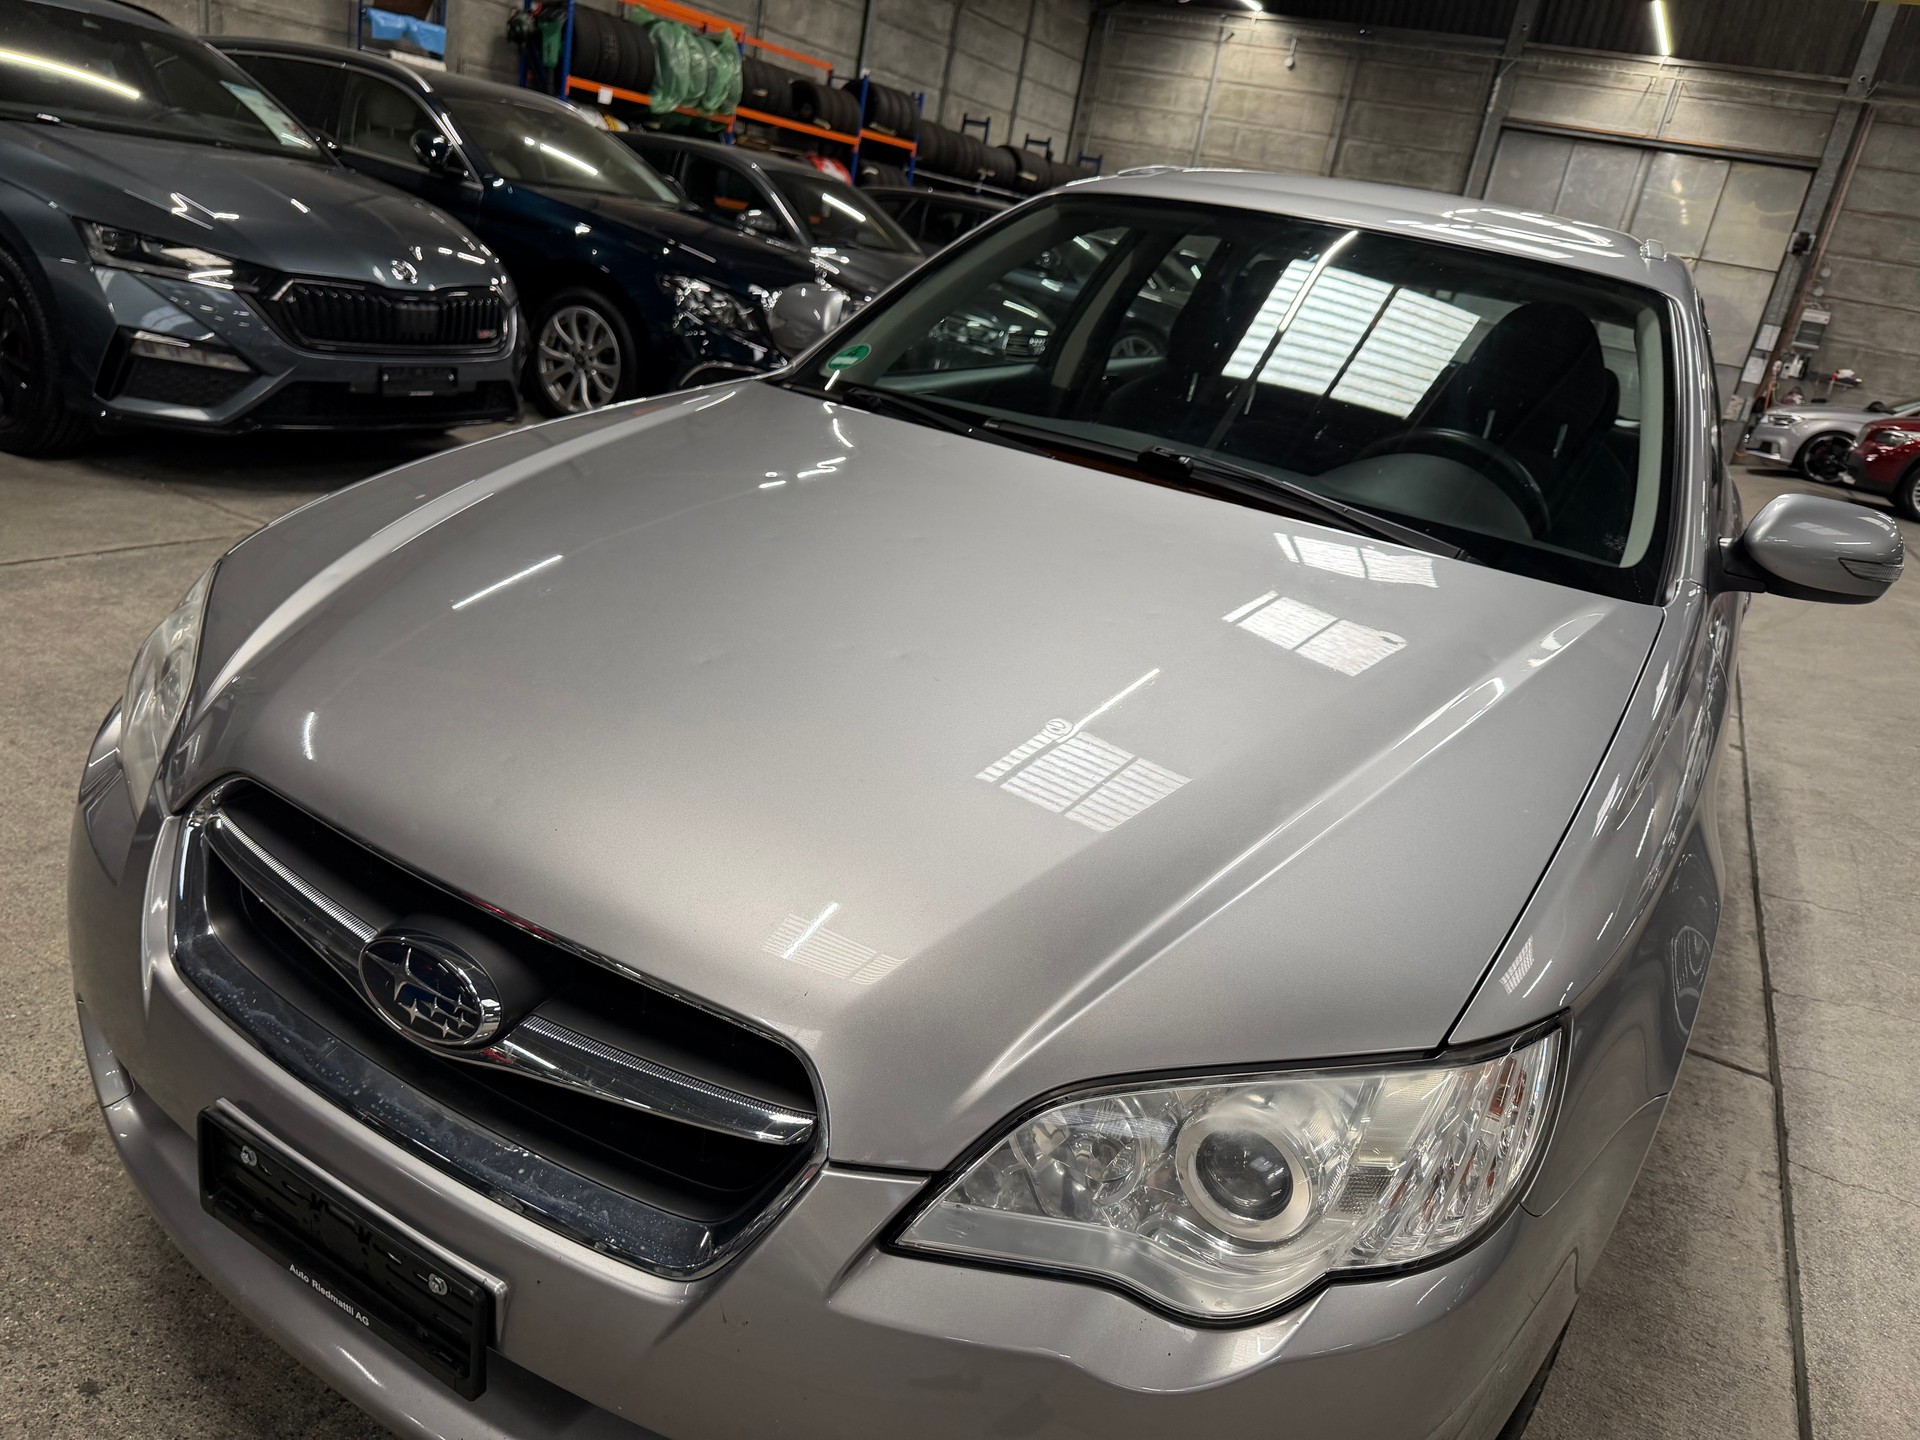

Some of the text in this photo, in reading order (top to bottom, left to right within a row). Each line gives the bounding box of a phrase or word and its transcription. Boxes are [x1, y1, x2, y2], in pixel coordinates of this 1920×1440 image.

[289, 1264, 370, 1326] Auto Riedmattli AG
